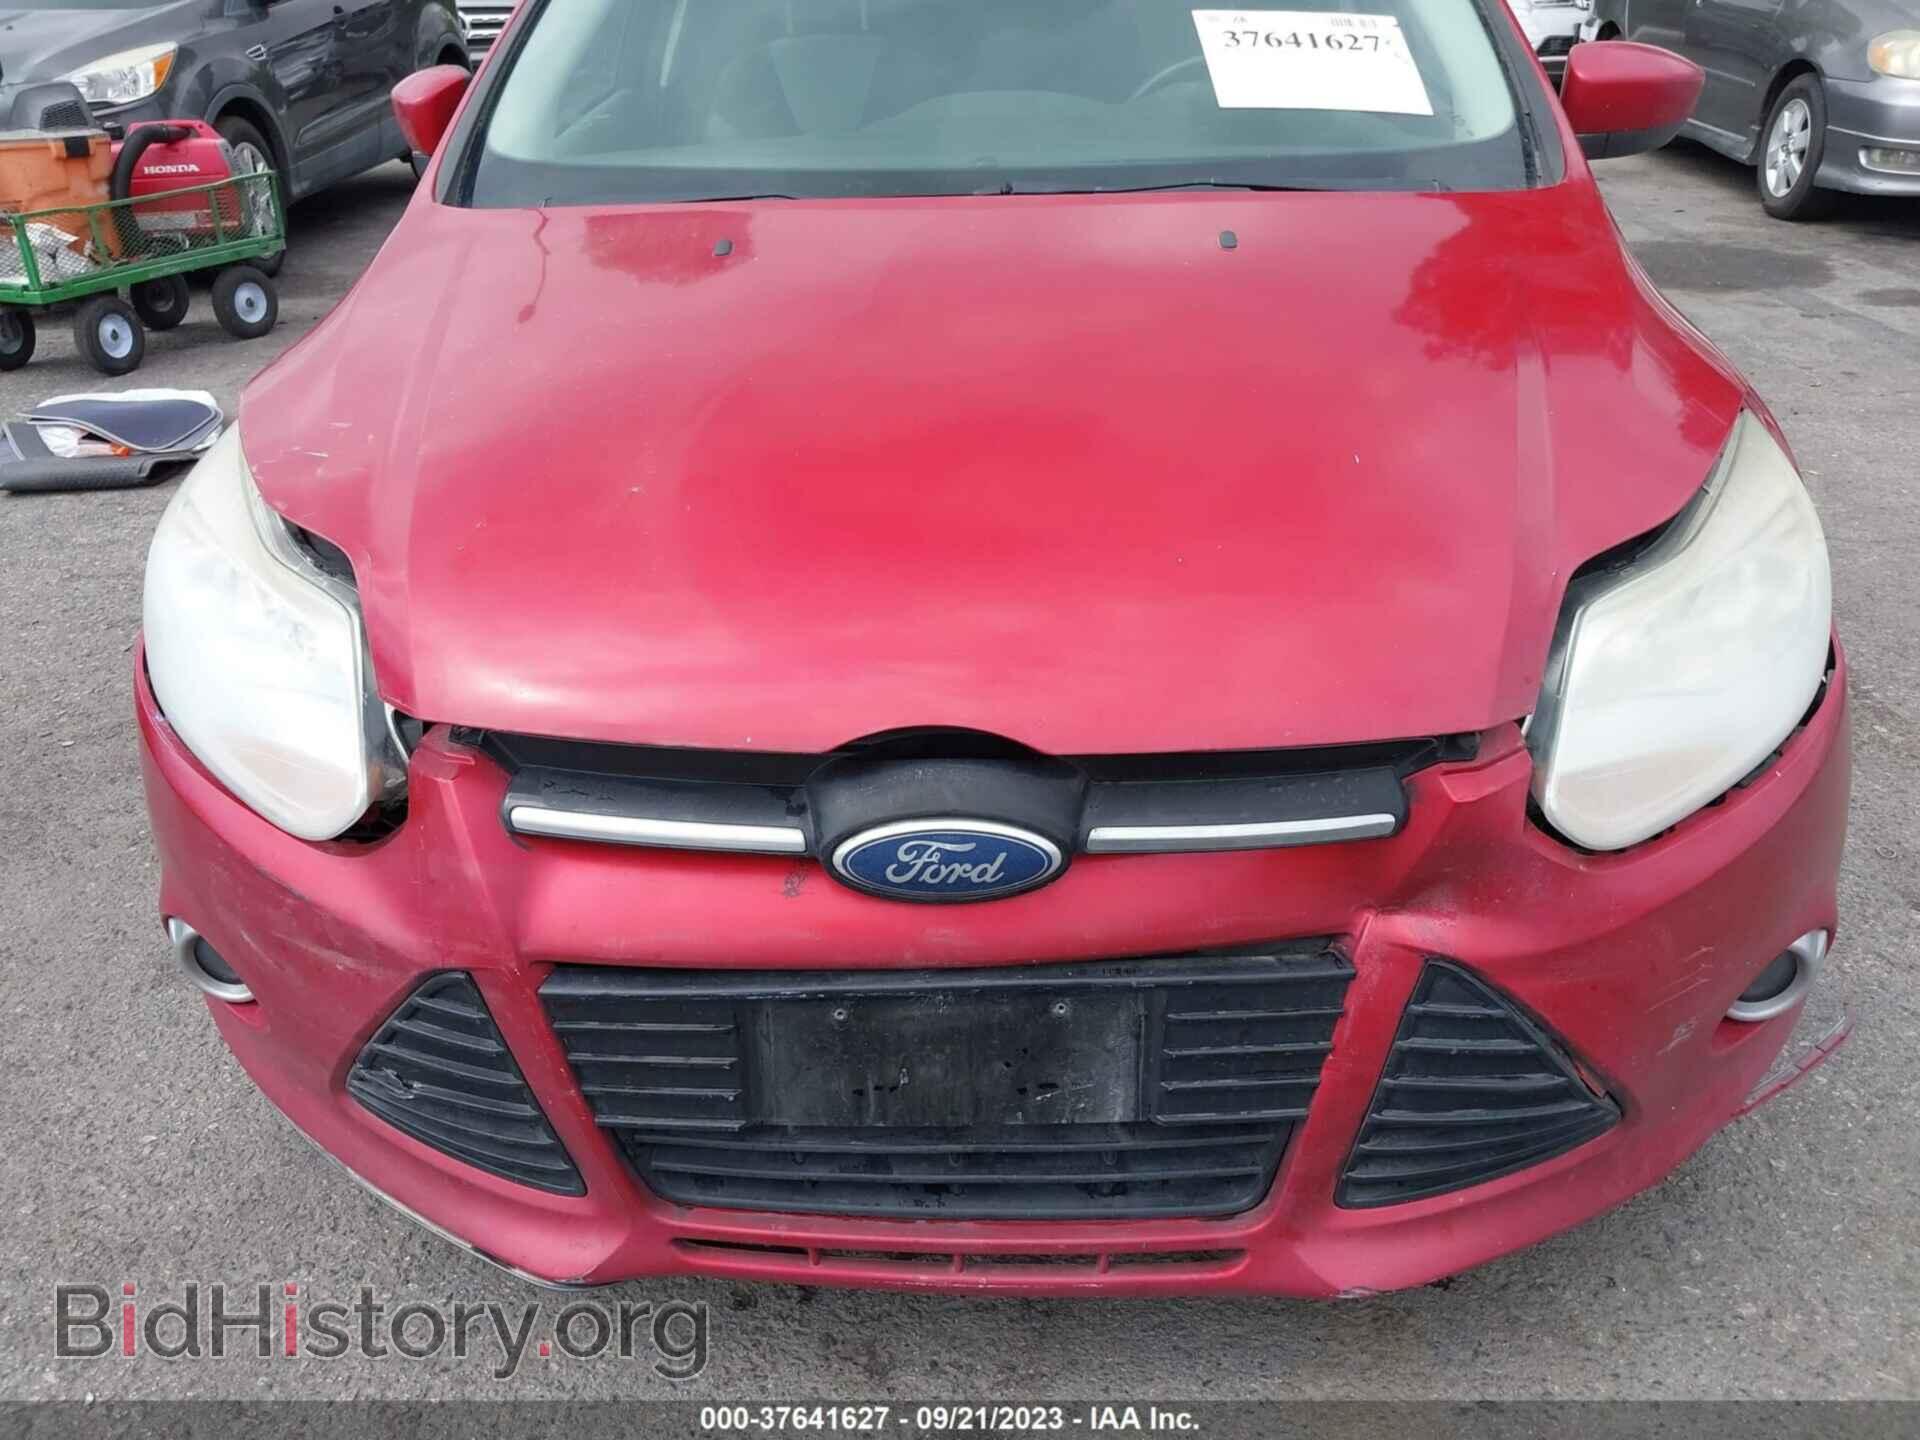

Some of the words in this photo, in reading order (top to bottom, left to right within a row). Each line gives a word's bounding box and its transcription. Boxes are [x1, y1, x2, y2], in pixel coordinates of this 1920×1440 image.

[1224, 30, 1380, 52] 37641627
[143, 164, 200, 174] HONDA
[885, 840, 1008, 884] Ford
